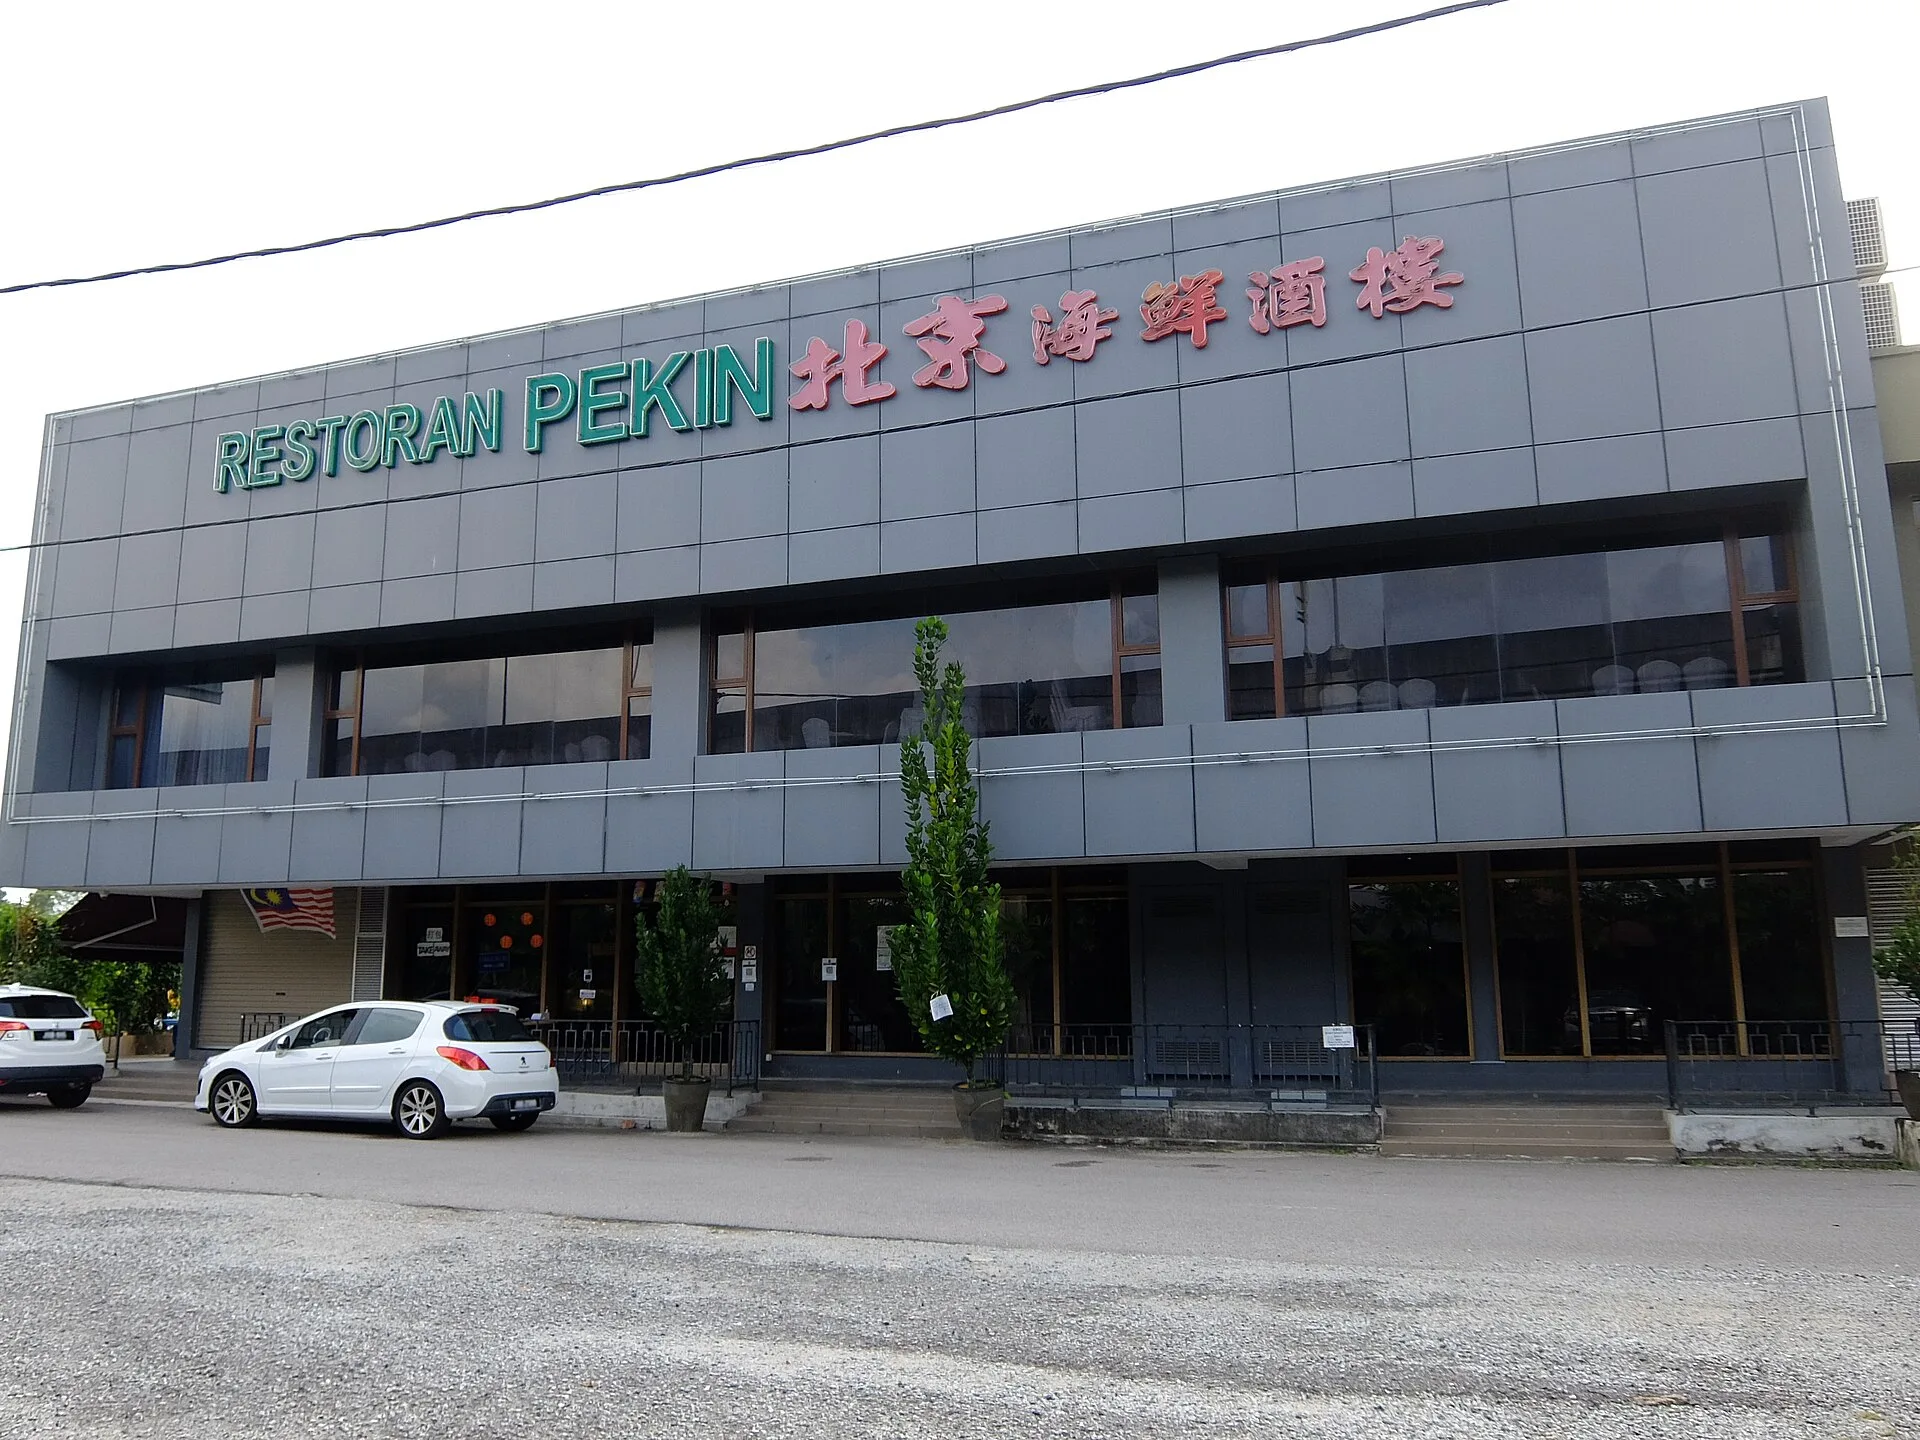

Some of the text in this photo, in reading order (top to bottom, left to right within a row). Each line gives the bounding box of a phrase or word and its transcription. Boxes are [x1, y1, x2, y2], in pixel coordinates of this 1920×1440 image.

[788, 236, 1464, 410] 北京海鮮酒樓
[213, 337, 773, 493] RESTORAN PEKIN
